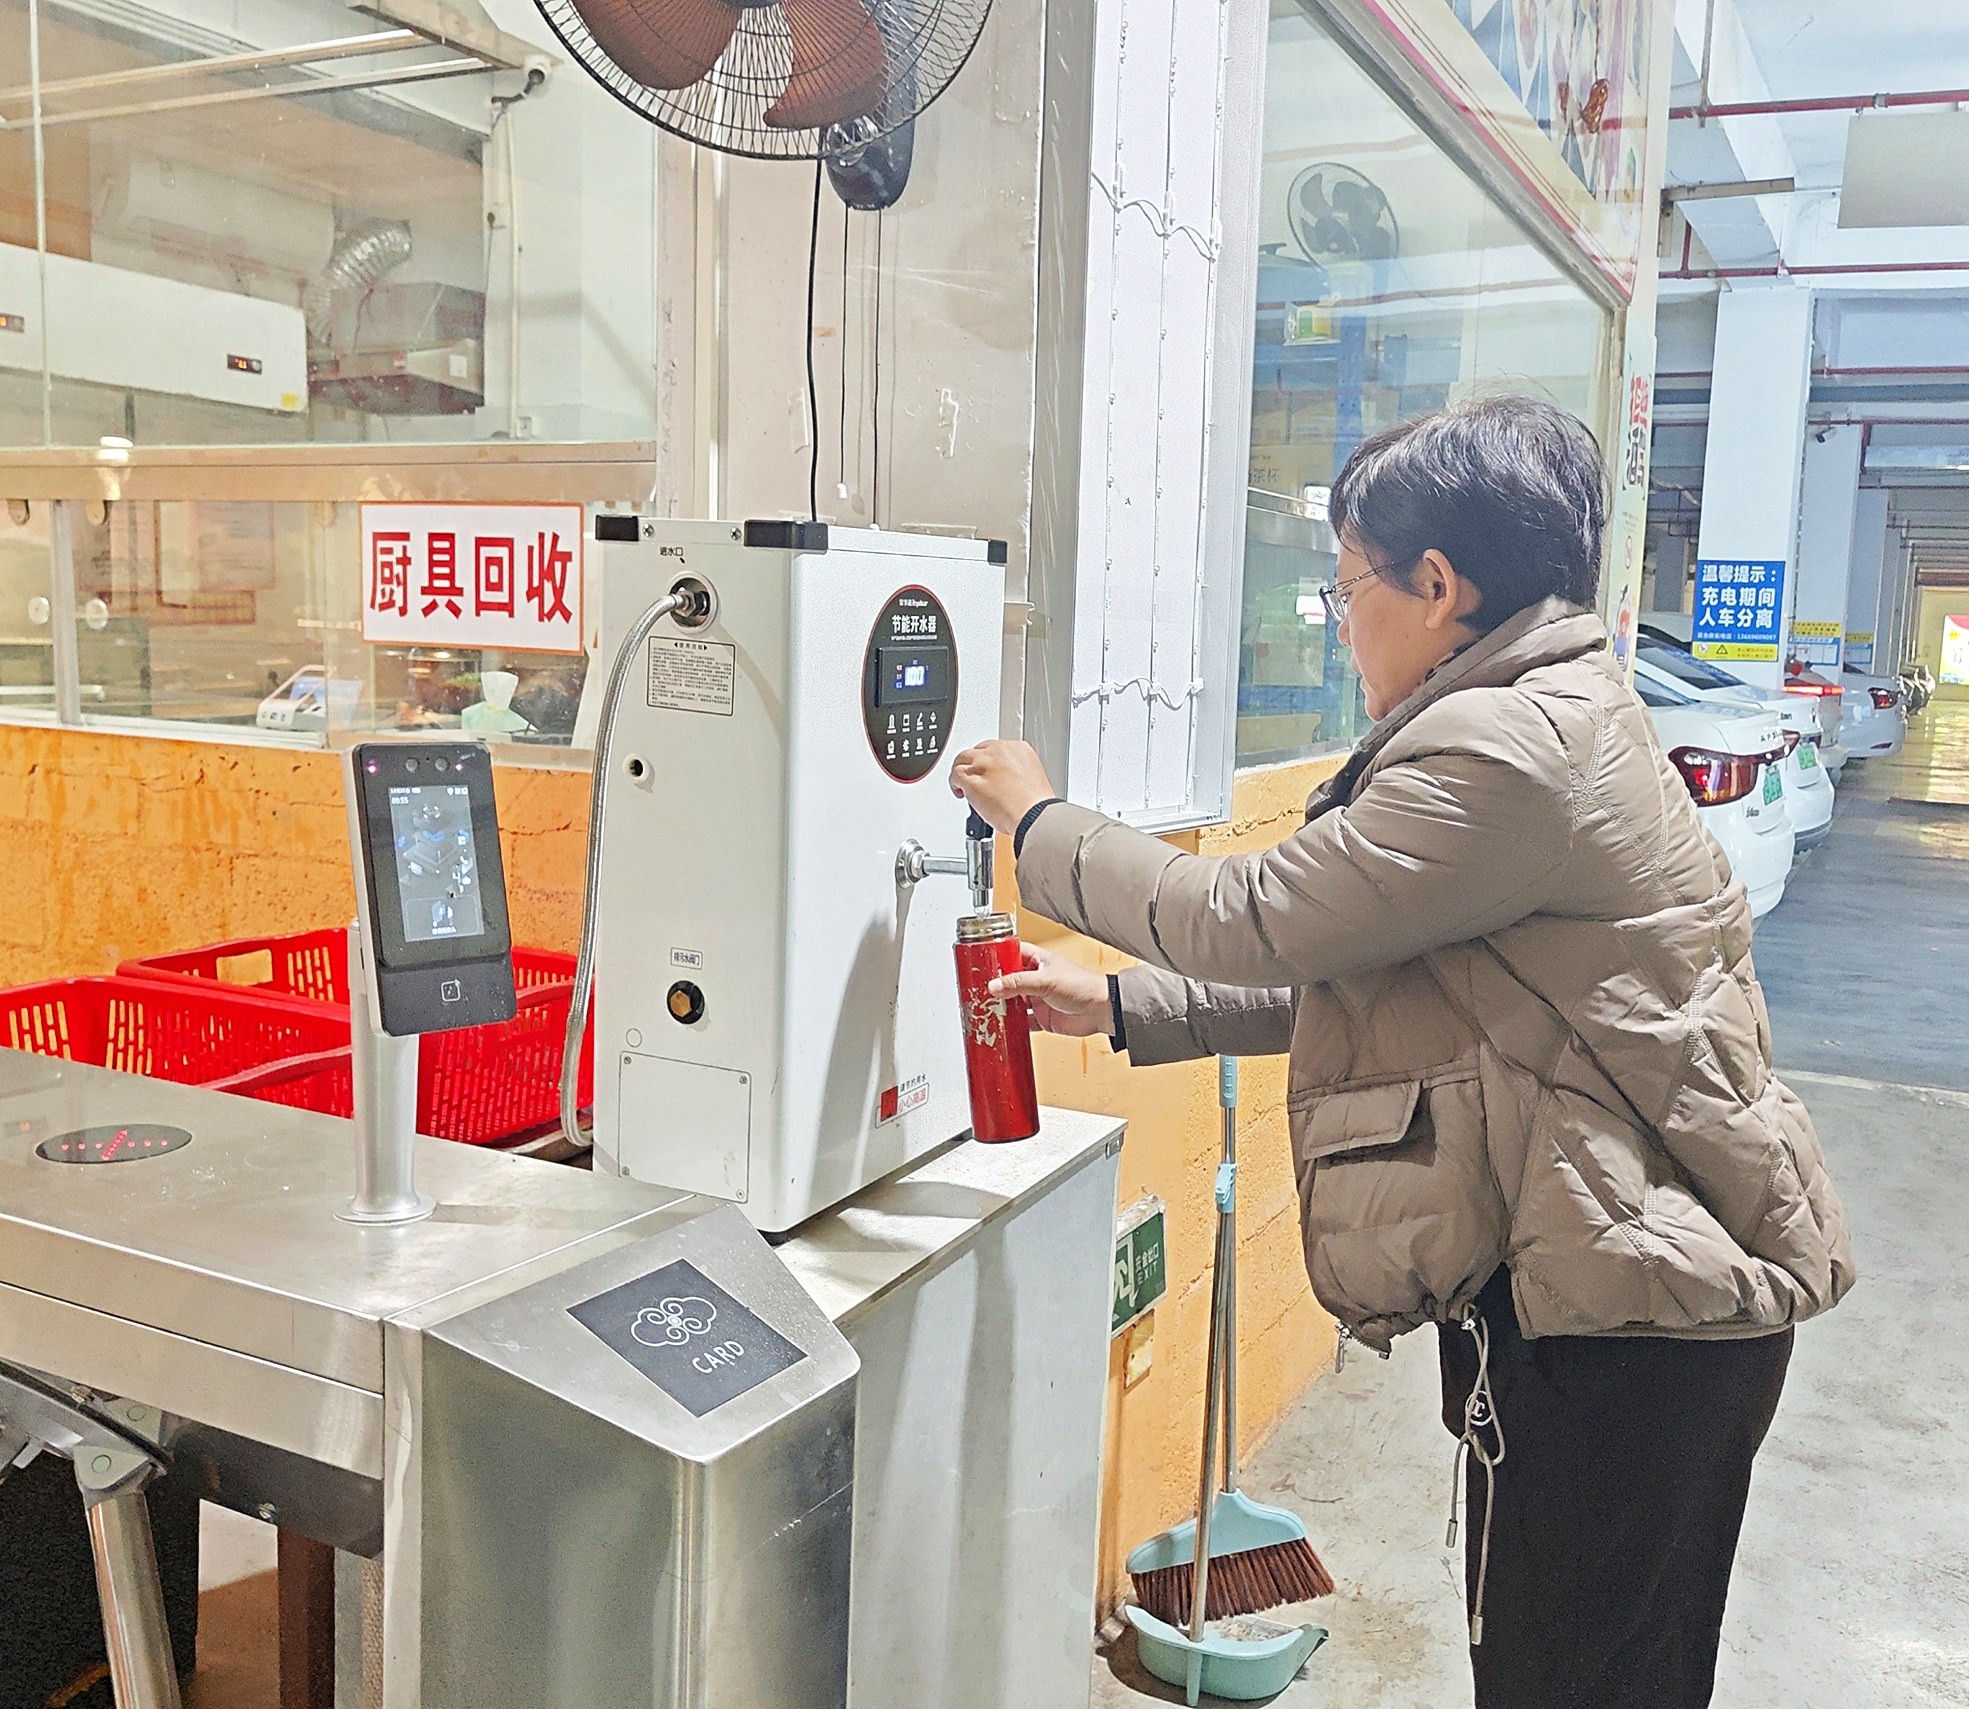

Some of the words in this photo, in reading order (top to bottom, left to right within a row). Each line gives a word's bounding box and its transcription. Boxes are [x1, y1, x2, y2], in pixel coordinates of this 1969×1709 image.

[660, 547, 683, 556] 进水口
[370, 531, 573, 624] 厨具回收
[1702, 564, 1776, 583] 温馨提示：
[1701, 586, 1776, 607] 充电期间
[892, 615, 937, 633] 节能开水器
[1699, 607, 1774, 628] 人车分离
[1137, 1260, 1158, 1285] EXIT
[692, 1341, 745, 1374] CARD
